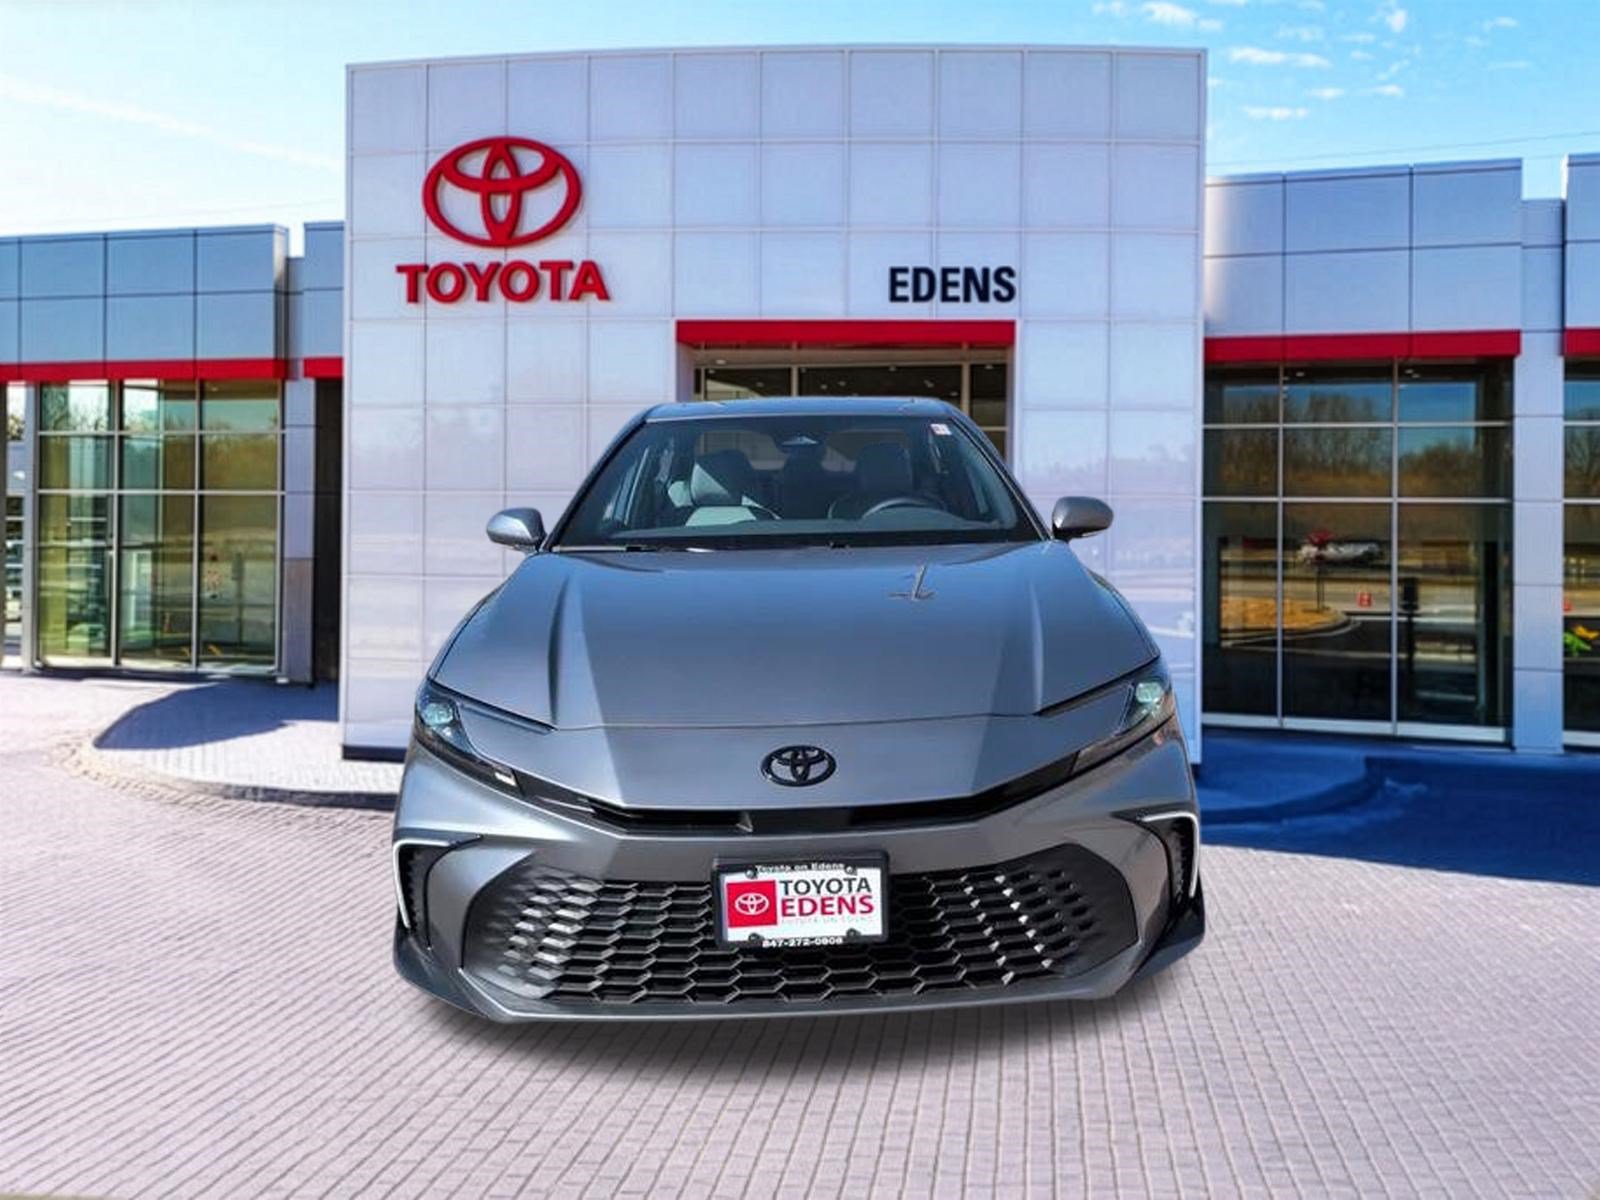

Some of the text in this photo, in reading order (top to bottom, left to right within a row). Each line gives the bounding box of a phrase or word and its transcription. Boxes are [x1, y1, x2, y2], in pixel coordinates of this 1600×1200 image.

[396, 260, 610, 304] TOYOTA
[889, 266, 1017, 303] EDENS
[811, 863, 845, 871] Edens
[779, 877, 871, 896] TOYOTA
[781, 895, 874, 918] EDENS
